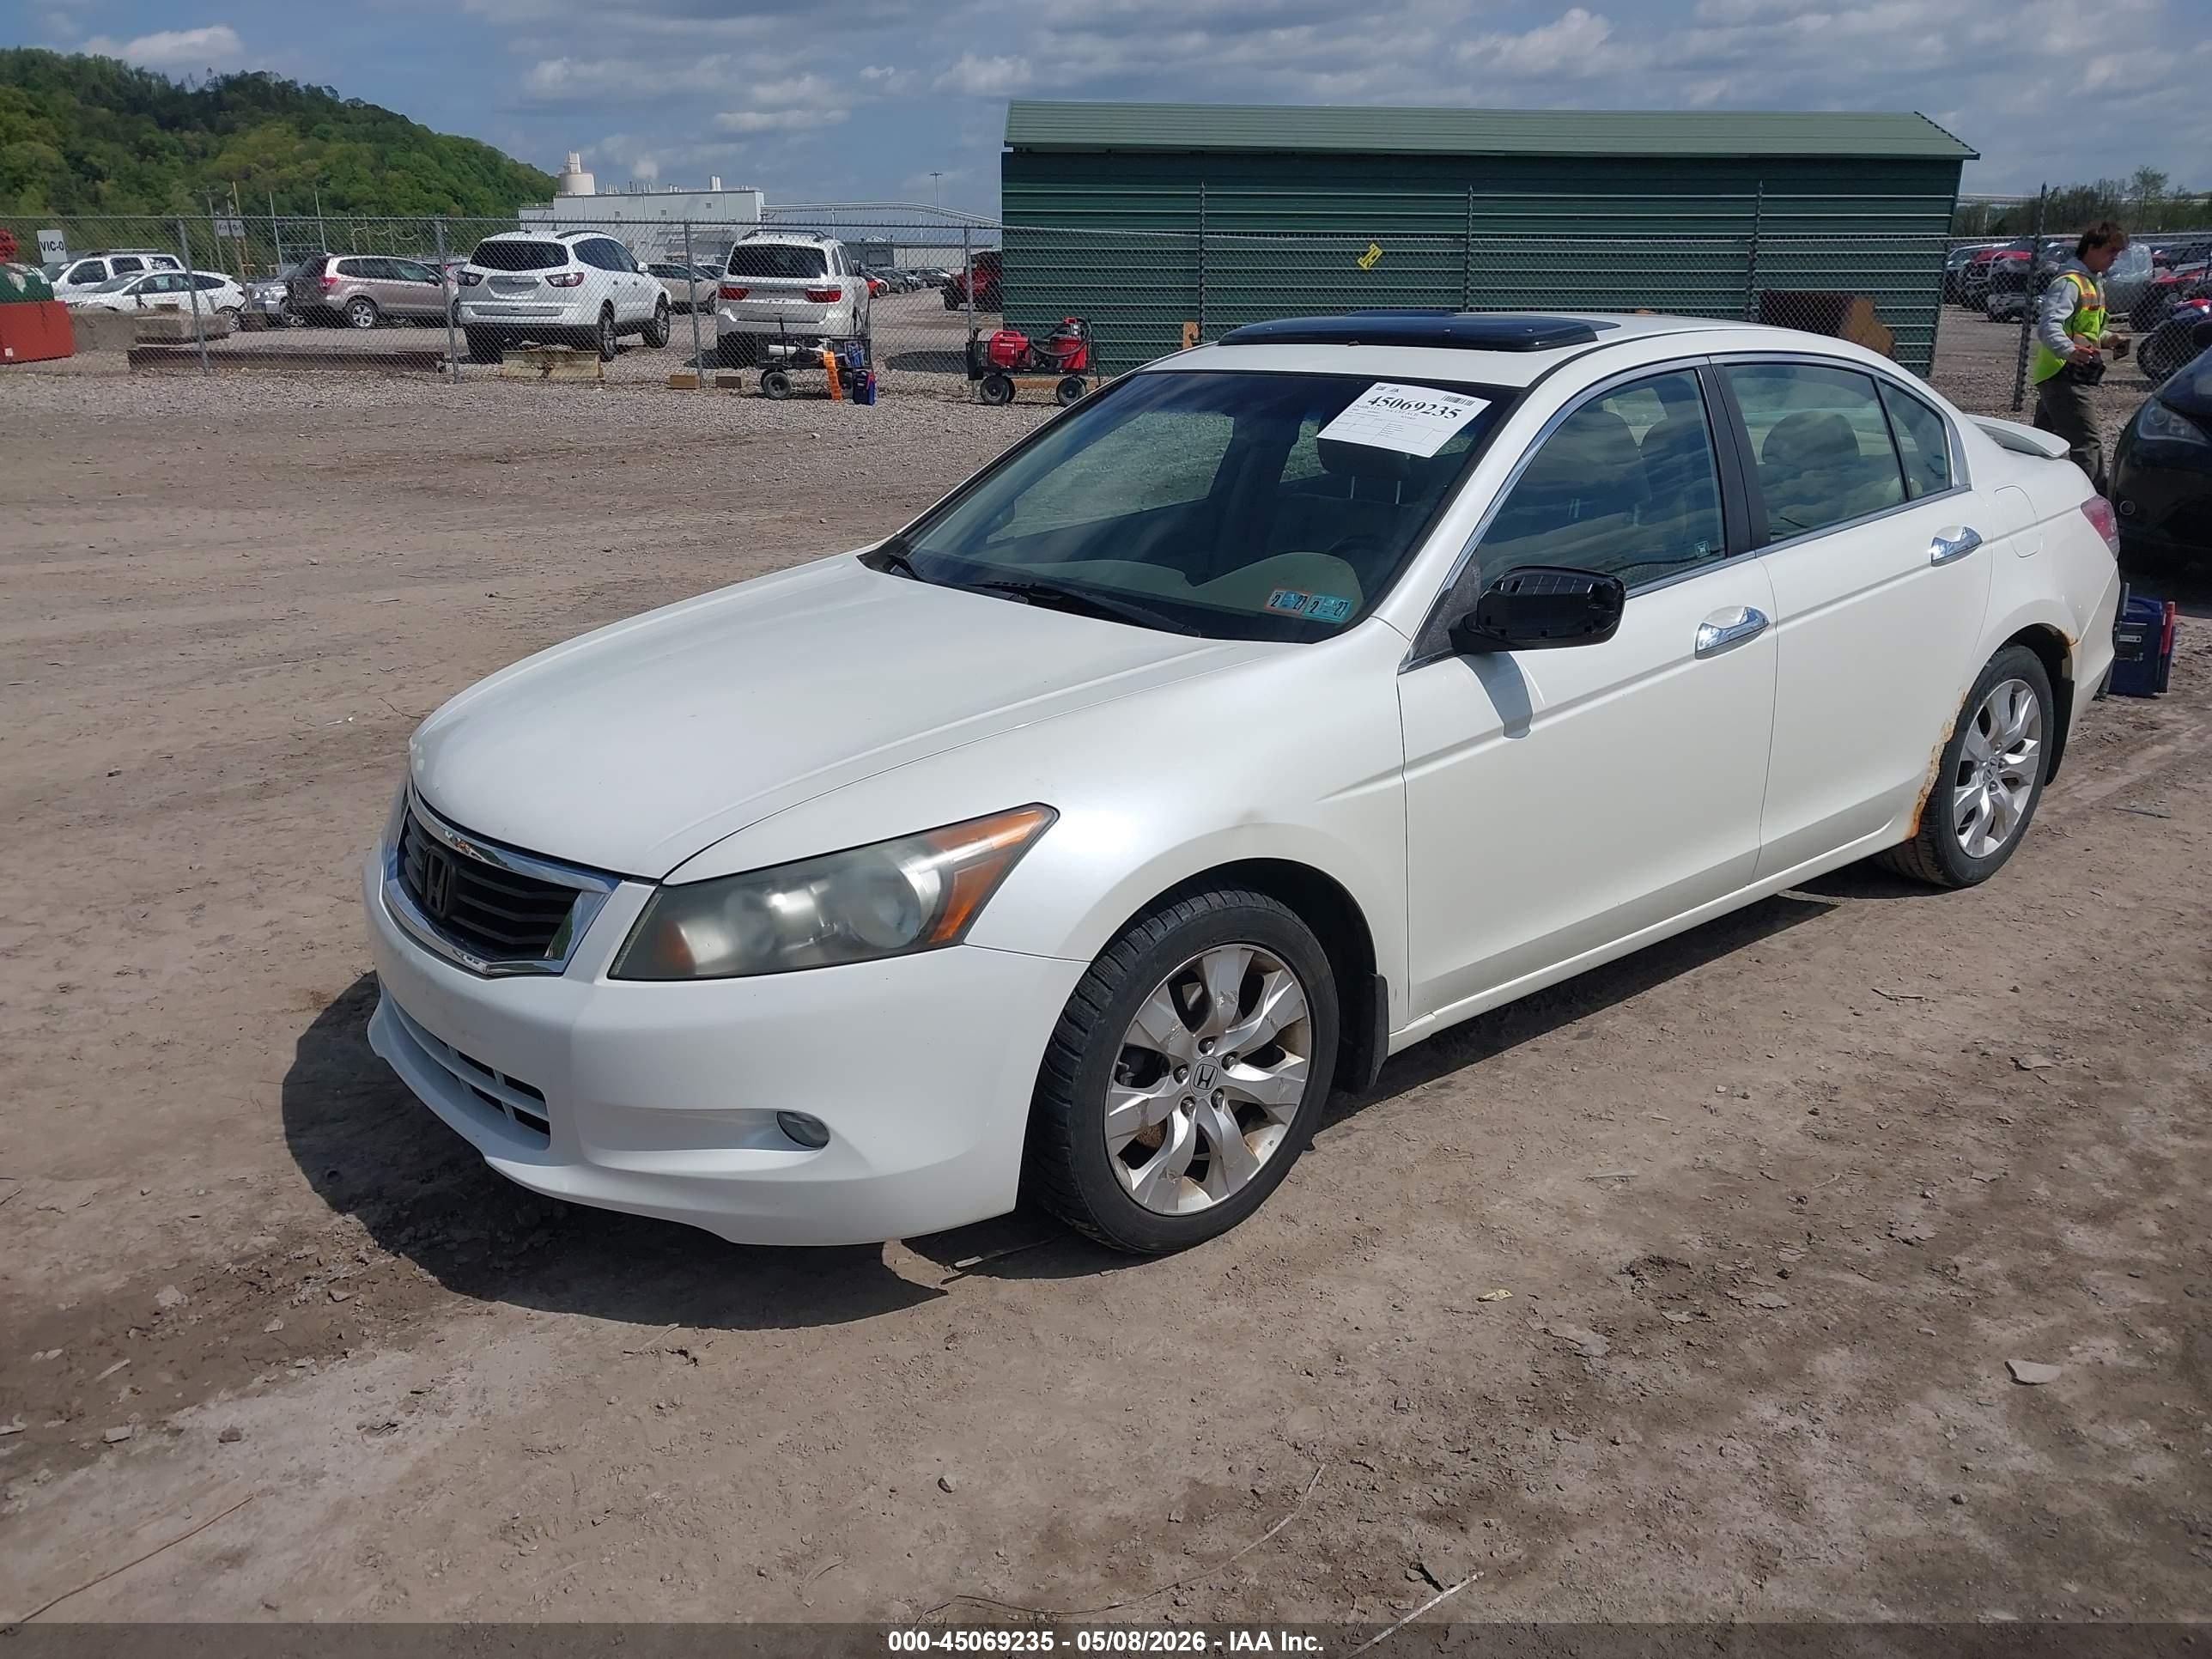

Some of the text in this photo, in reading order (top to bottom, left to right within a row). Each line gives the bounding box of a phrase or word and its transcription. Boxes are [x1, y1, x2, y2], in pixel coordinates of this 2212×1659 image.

[1368, 396, 1462, 419] 45069235
[1292, 595, 1308, 611] 27
[1334, 601, 1348, 617] 27
